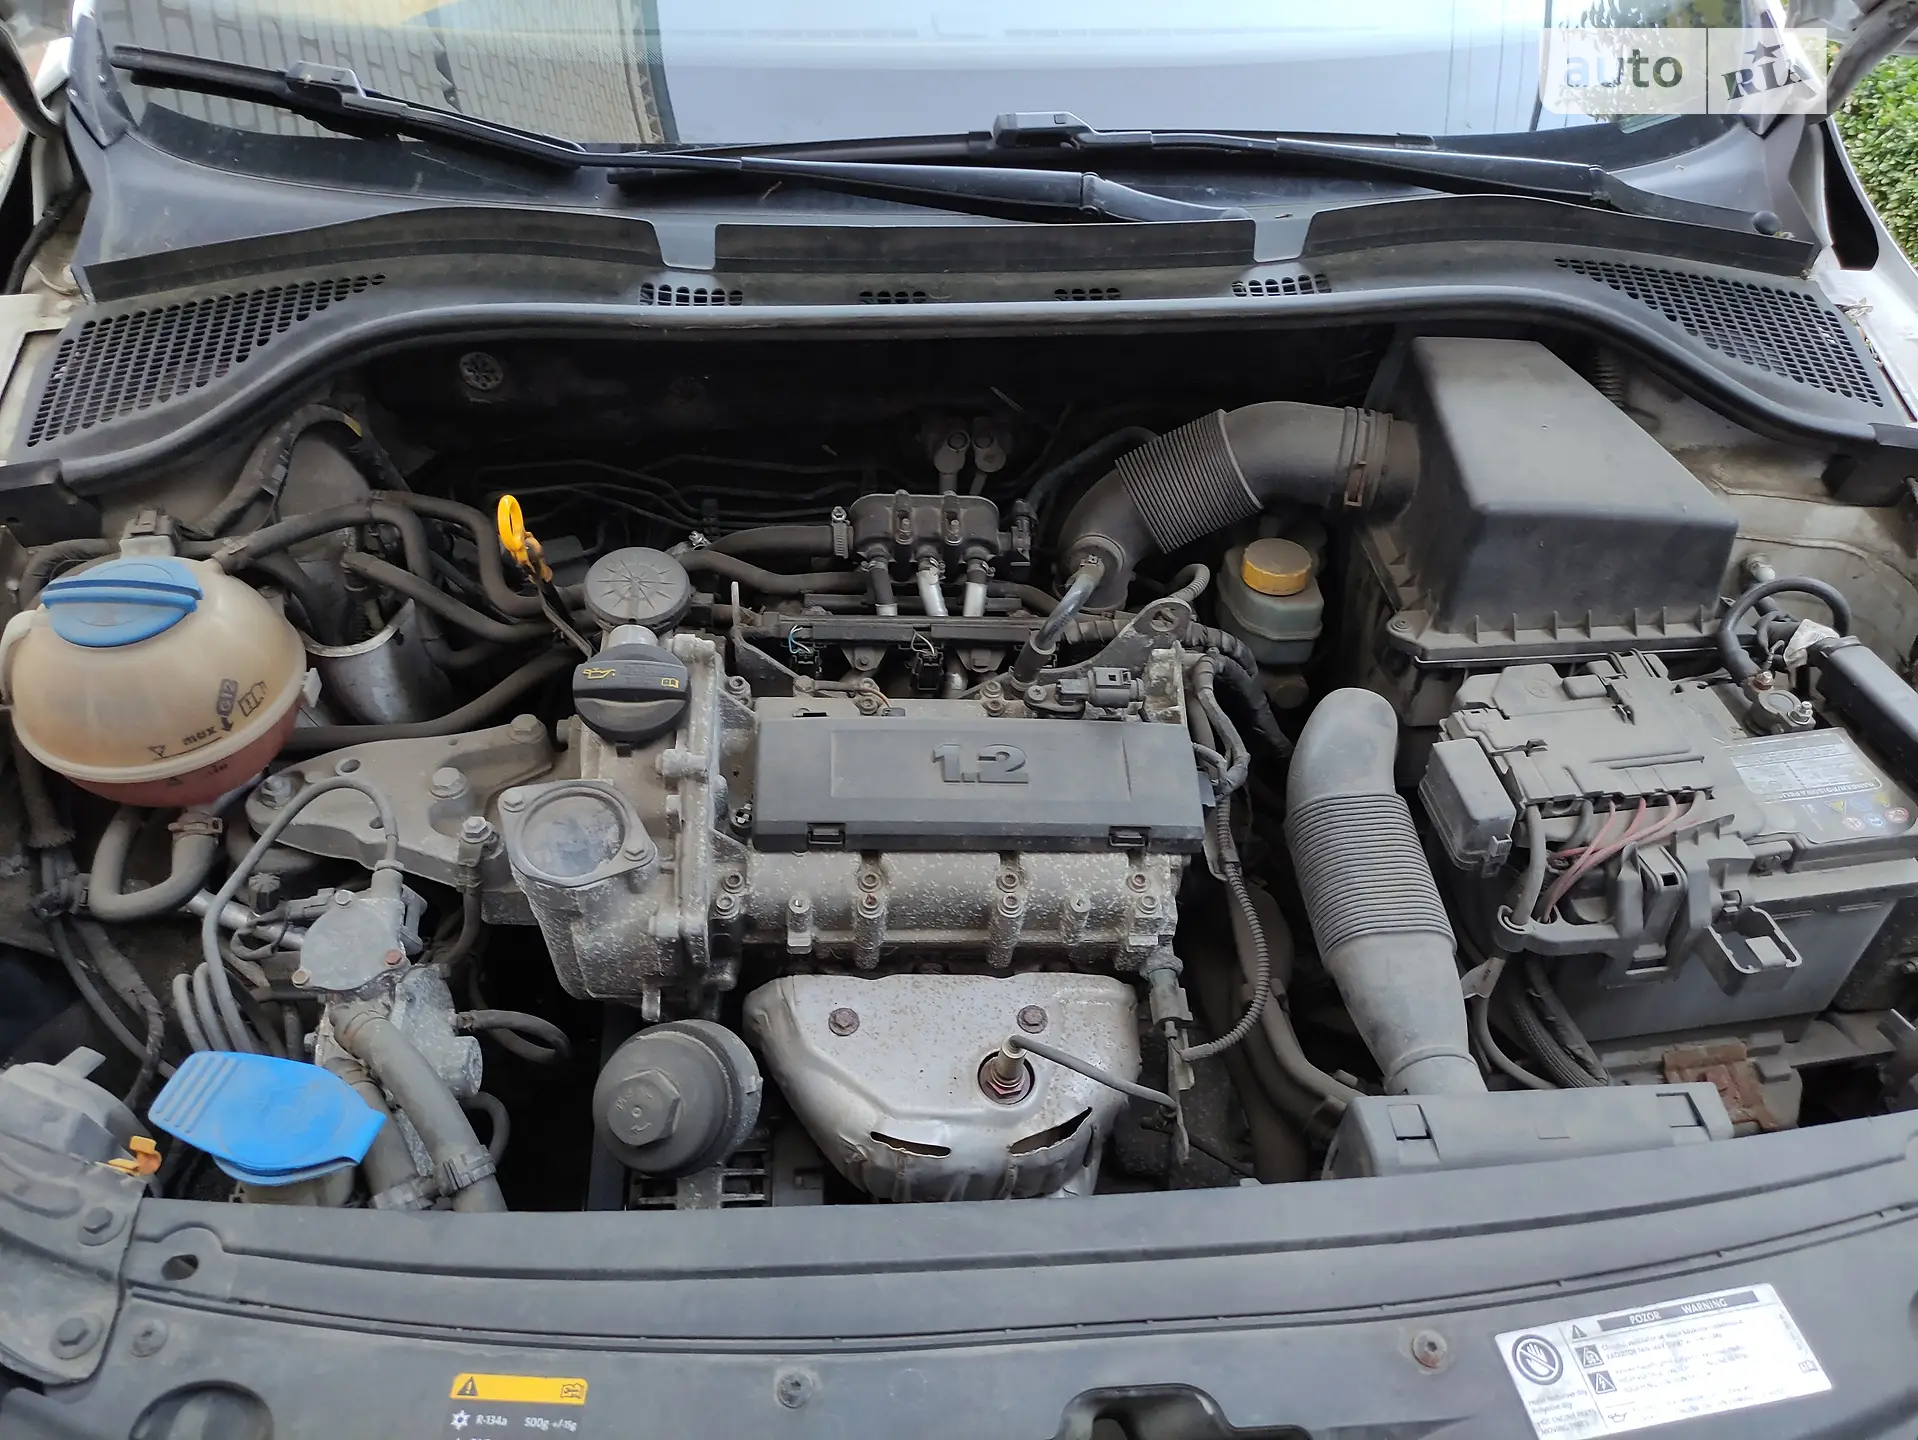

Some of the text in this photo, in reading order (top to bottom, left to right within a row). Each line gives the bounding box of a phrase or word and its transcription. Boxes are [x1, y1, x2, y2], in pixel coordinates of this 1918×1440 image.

[182, 726, 217, 746] max
[931, 743, 1029, 784] 1.2
[1629, 1298, 1728, 1325] POZOR WARNING
[524, 1417, 549, 1431] 500g
